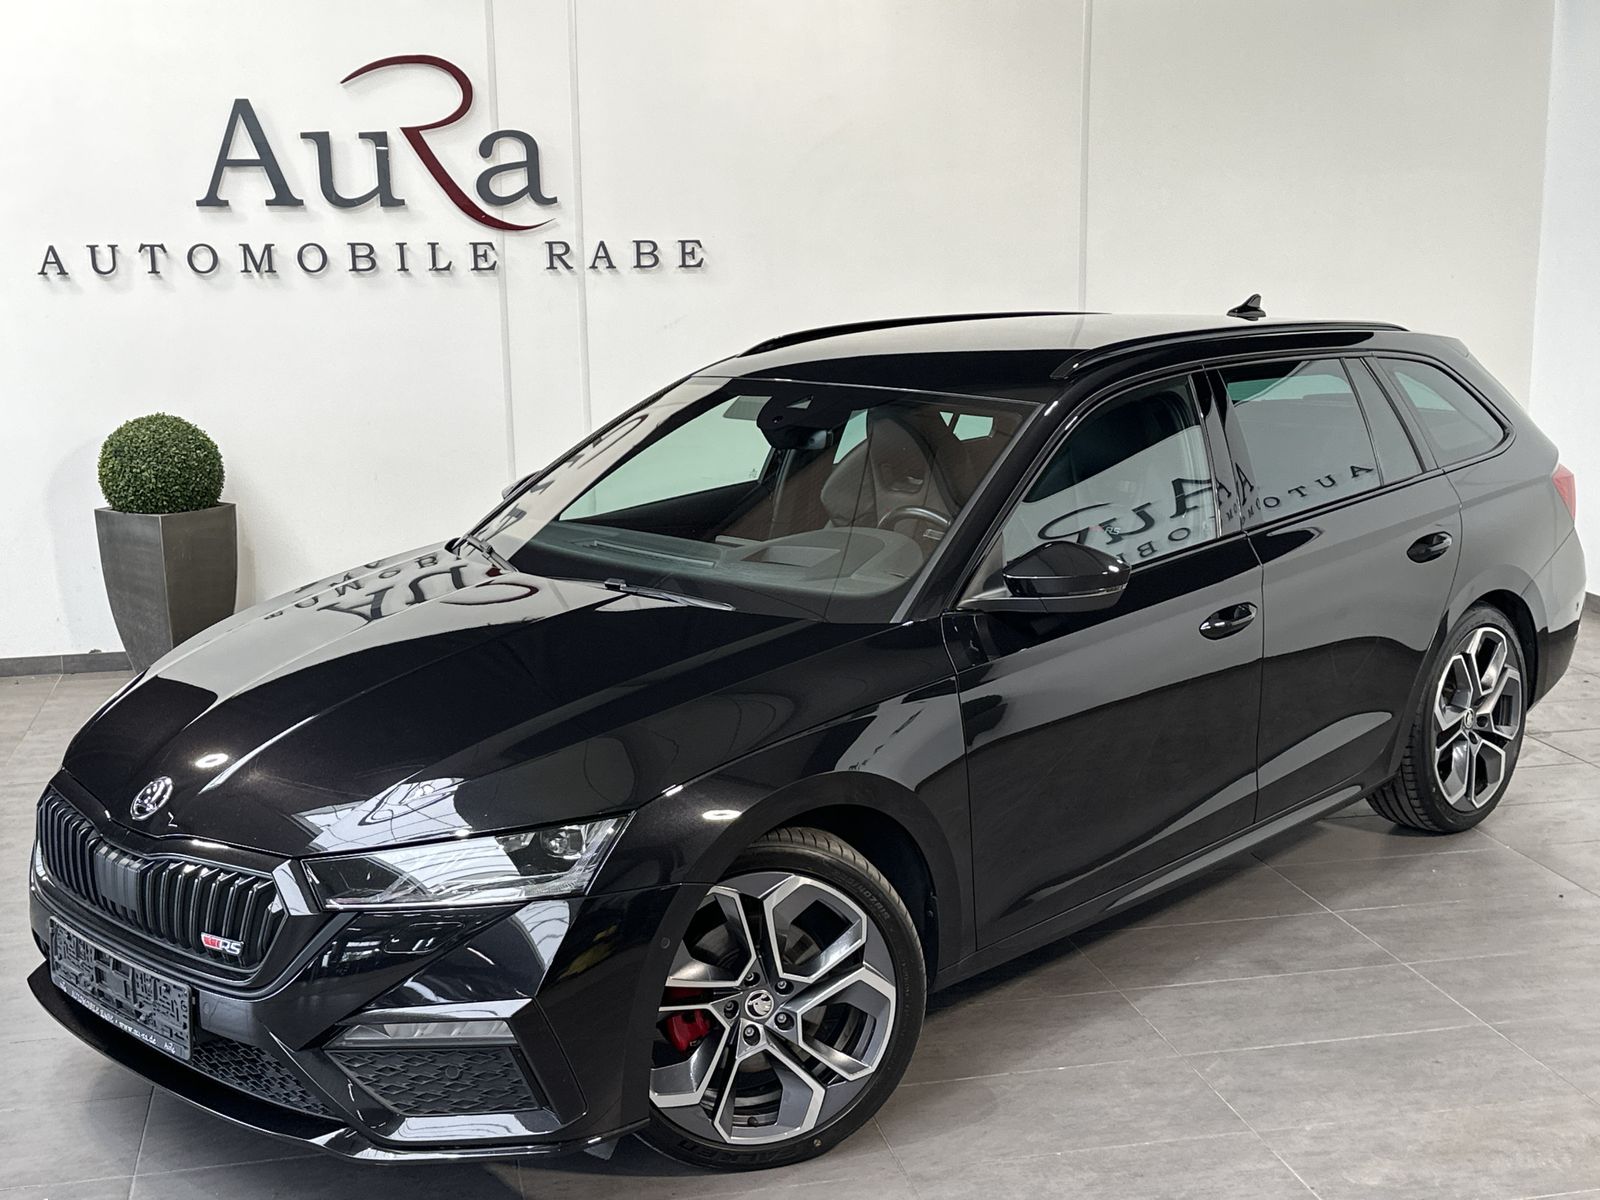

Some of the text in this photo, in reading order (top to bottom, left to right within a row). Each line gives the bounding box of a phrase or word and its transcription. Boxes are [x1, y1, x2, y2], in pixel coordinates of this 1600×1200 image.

[195, 54, 557, 231] AuRa
[37, 239, 705, 275] AUTOMOBILE RABE
